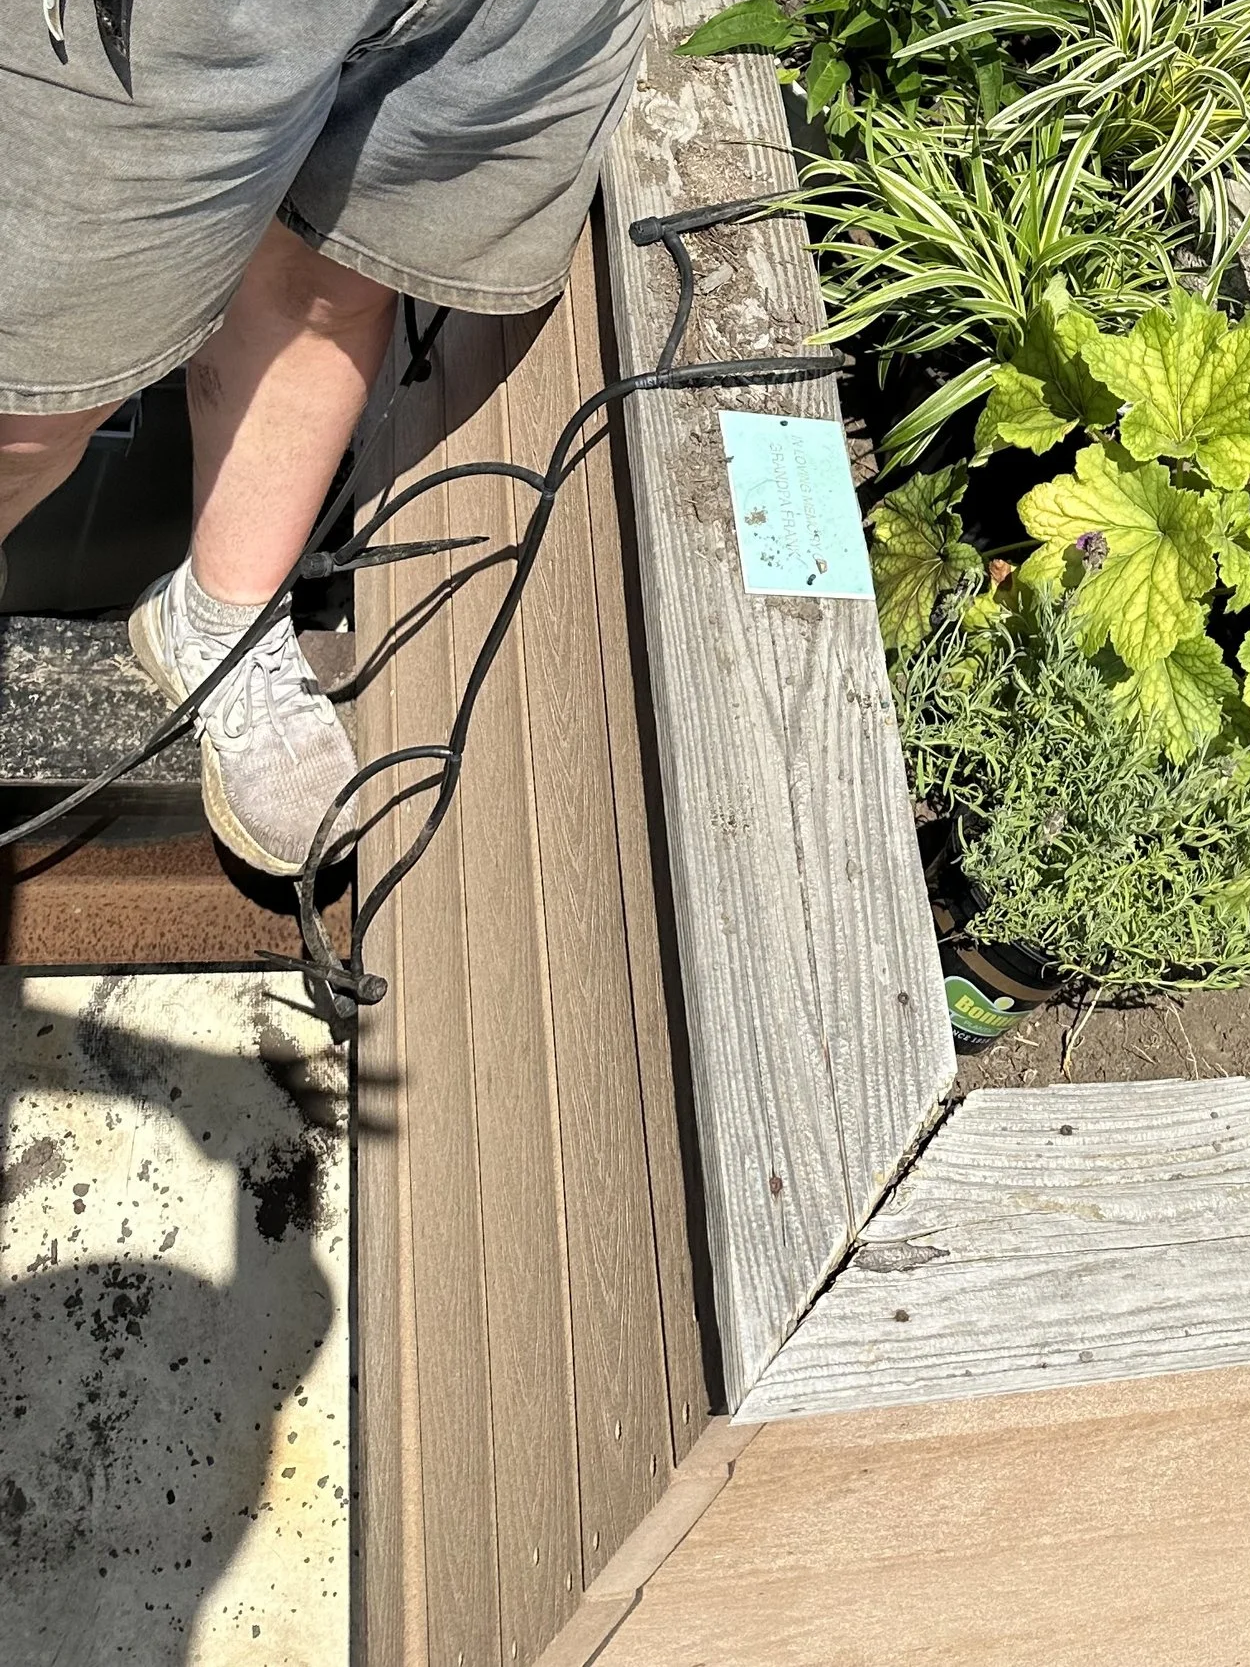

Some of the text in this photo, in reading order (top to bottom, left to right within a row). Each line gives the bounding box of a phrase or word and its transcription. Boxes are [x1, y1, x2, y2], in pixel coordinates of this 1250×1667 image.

[793, 449, 812, 494] LOVING
[769, 442, 804, 561] GRANDPA FRANK
[802, 495, 822, 551] MEMORY
[952, 1028, 972, 1042] NCE
